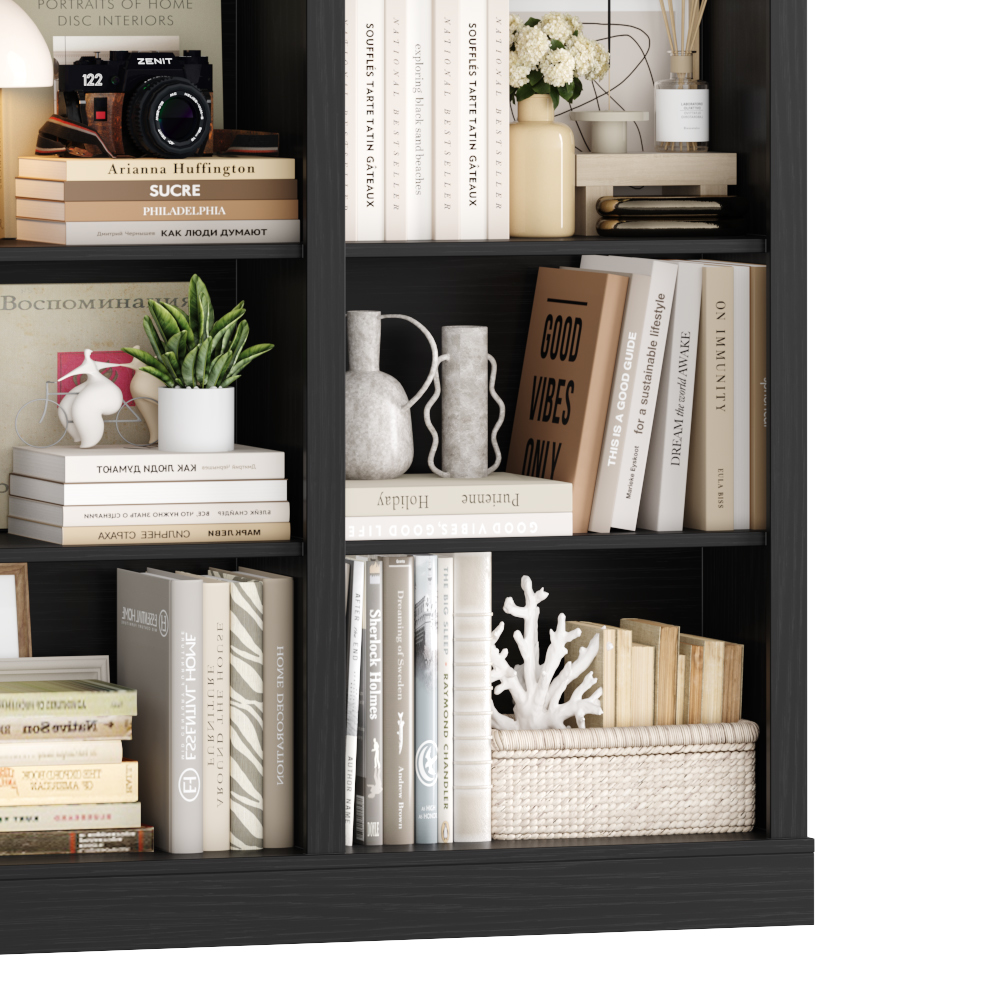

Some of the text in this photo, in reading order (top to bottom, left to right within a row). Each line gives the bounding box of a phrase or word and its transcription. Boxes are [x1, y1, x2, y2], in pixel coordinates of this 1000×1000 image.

[58, 16, 174, 26] DISC INTERIORS
[82, 74, 104, 86] 122
[413, 44, 424, 196] exploring black sand beaches
[108, 163, 255, 176] Arianna Huffington
[150, 184, 200, 197] SUCRE
[143, 206, 226, 216] PHILADELPHIA
[540, 314, 582, 362] GOOD
[716, 300, 726, 413] ON IMMUNITY
[634, 418, 644, 434] for
[640, 340, 658, 405] sustainable
[649, 293, 666, 337] lifestyle
[529, 375, 574, 426] VIBES
[608, 331, 638, 467] THIS IS A GOOD GUIDE
[670, 331, 690, 466] DREAM the world AWAKE
[522, 438, 562, 480] ONLY
[626, 446, 640, 500] Marieke Eyskoot
[376, 492, 520, 510] Purienne Holiday
[370, 609, 381, 720] Sherlock Holmes
